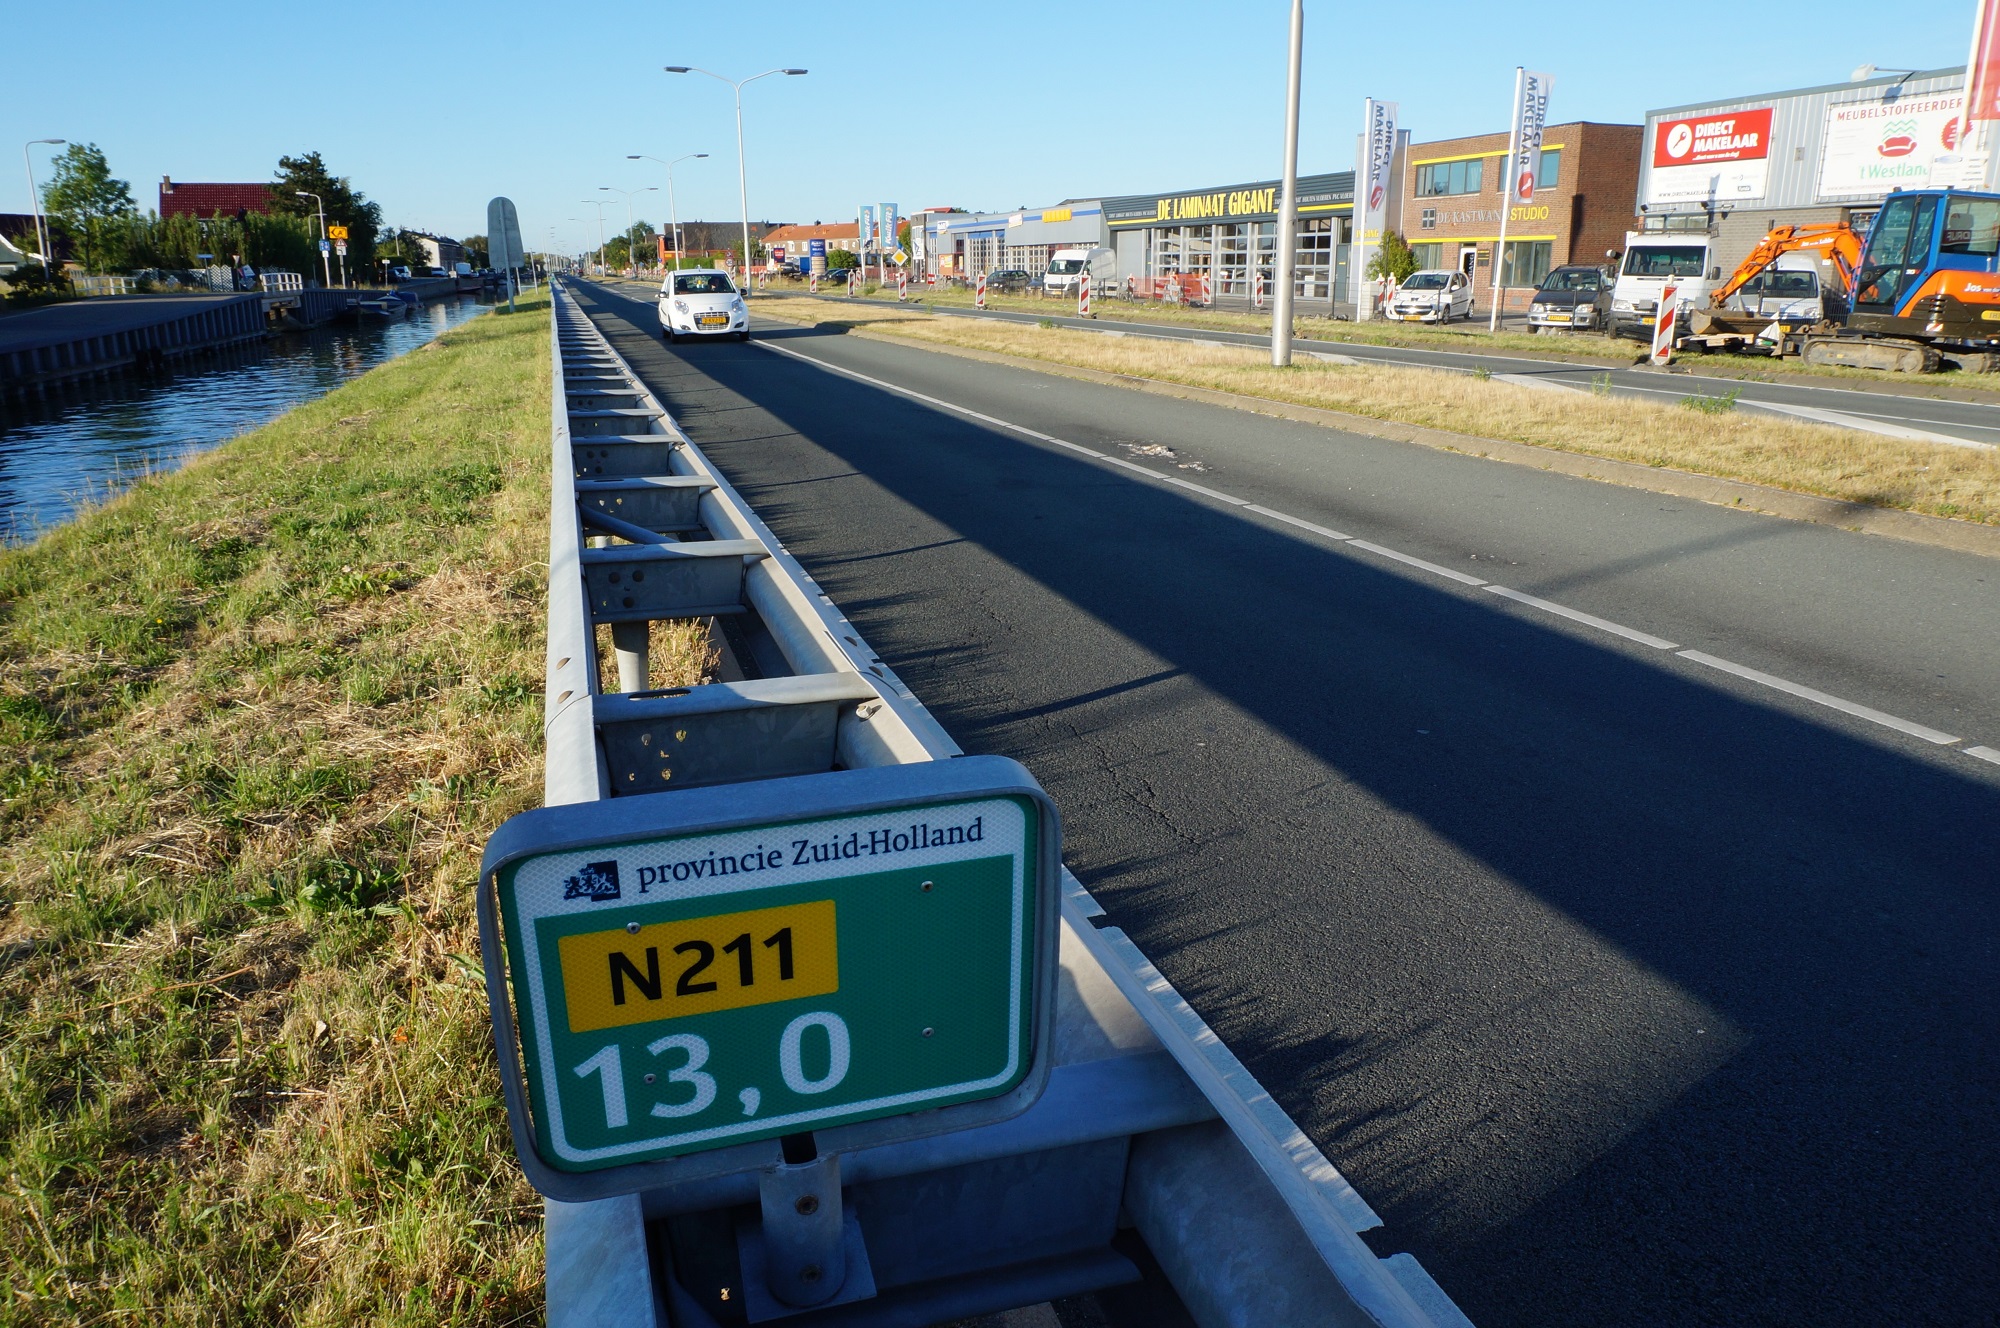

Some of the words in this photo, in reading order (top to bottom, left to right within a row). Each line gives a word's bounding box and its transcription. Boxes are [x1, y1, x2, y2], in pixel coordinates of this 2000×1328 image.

[1372, 105, 1384, 181] MAKELAAR
[1383, 121, 1393, 167] DIRECT
[1520, 76, 1538, 165] MAKELAAR
[1532, 96, 1547, 150] DIRECT
[1693, 133, 1758, 152] MAKELAAR
[1695, 120, 1736, 138] DIRECT
[1158, 199, 1171, 221] DE
[1173, 193, 1226, 220] LAMINAAT
[1228, 188, 1276, 215] GIGANT
[1437, 212, 1450, 224] DE
[1964, 282, 1982, 292] Jos
[636, 846, 782, 893] provincie
[792, 817, 983, 866] Zuid-Holland
[608, 927, 795, 1006] N211
[573, 1011, 851, 1129] 13,0
